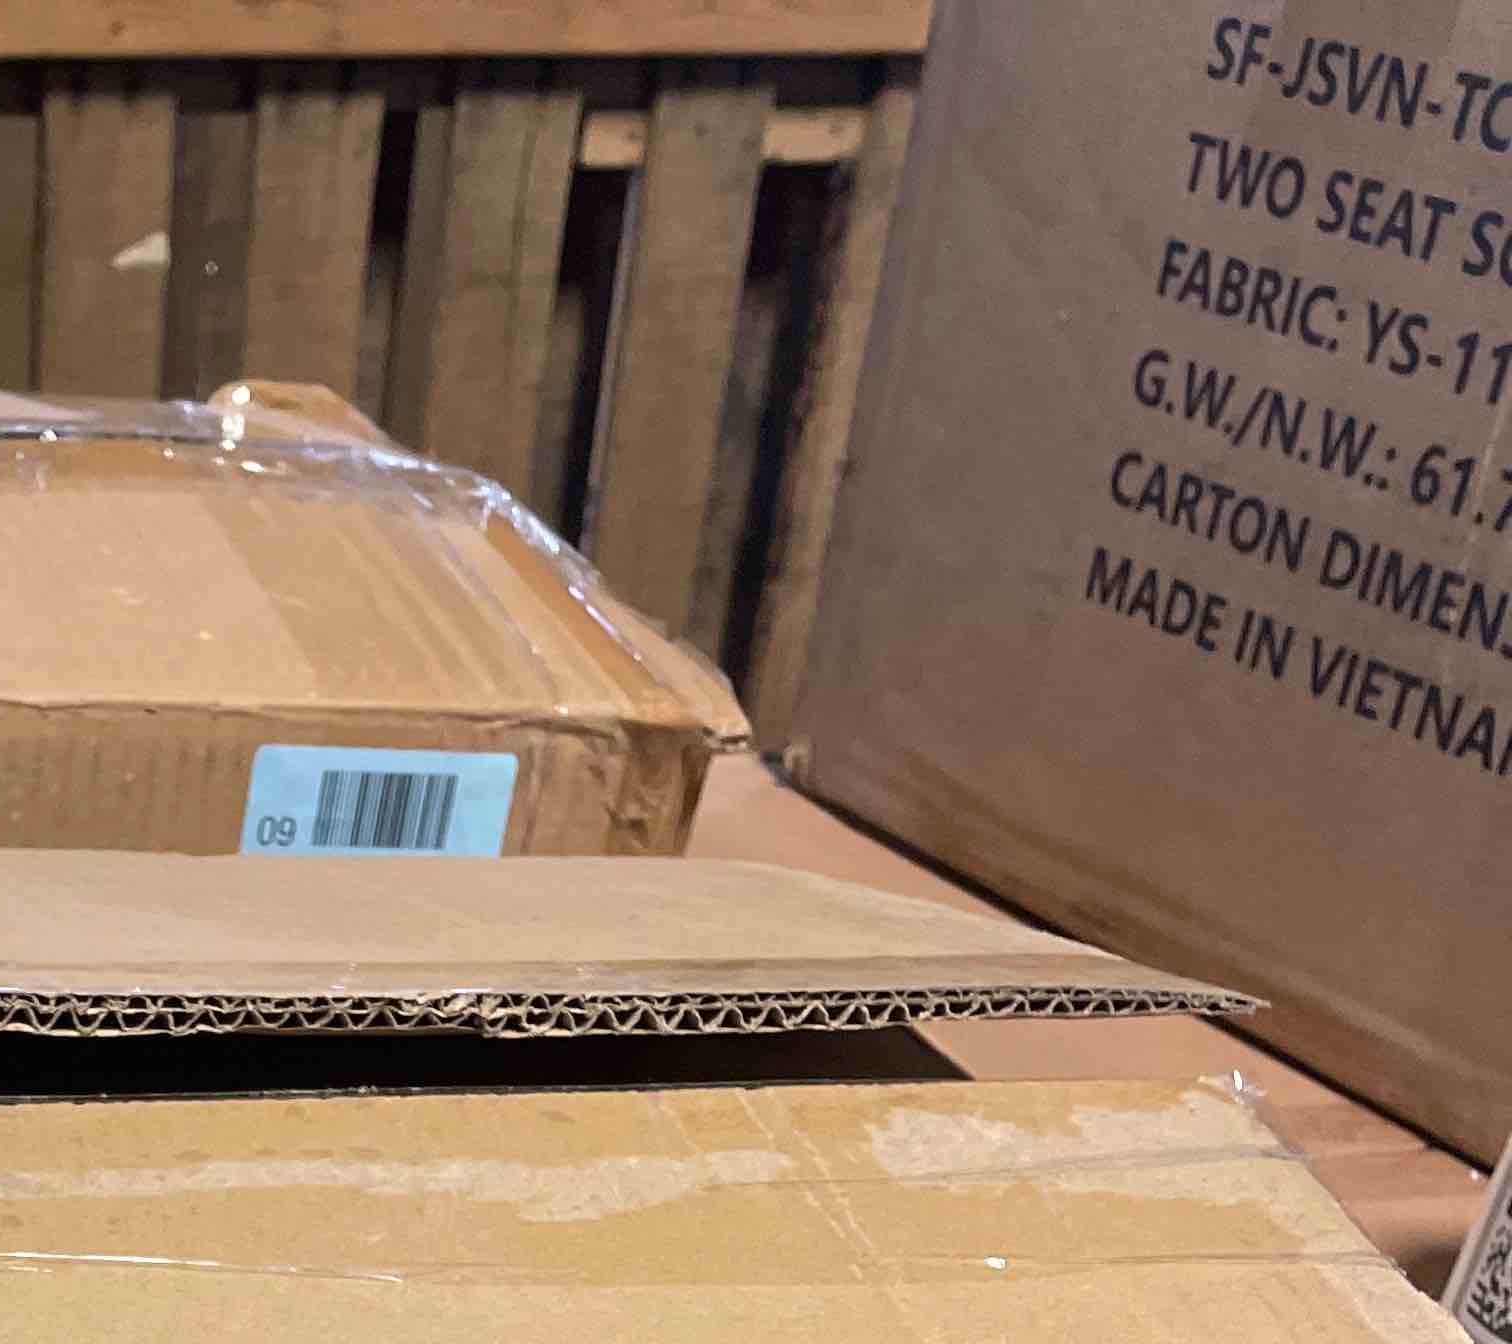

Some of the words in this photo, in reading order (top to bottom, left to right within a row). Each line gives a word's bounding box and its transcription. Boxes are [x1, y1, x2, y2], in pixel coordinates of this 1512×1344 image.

[1189, 132, 1305, 219] TWO
[1316, 170, 1457, 261] SEAT
[1157, 239, 1348, 351] FABRIC:
[1134, 350, 1397, 490] G.W./N.W.:
[1111, 452, 1311, 572] CARTON
[1087, 547, 1227, 651] MADE
[1235, 609, 1294, 680] IN
[256, 815, 297, 846] 09
